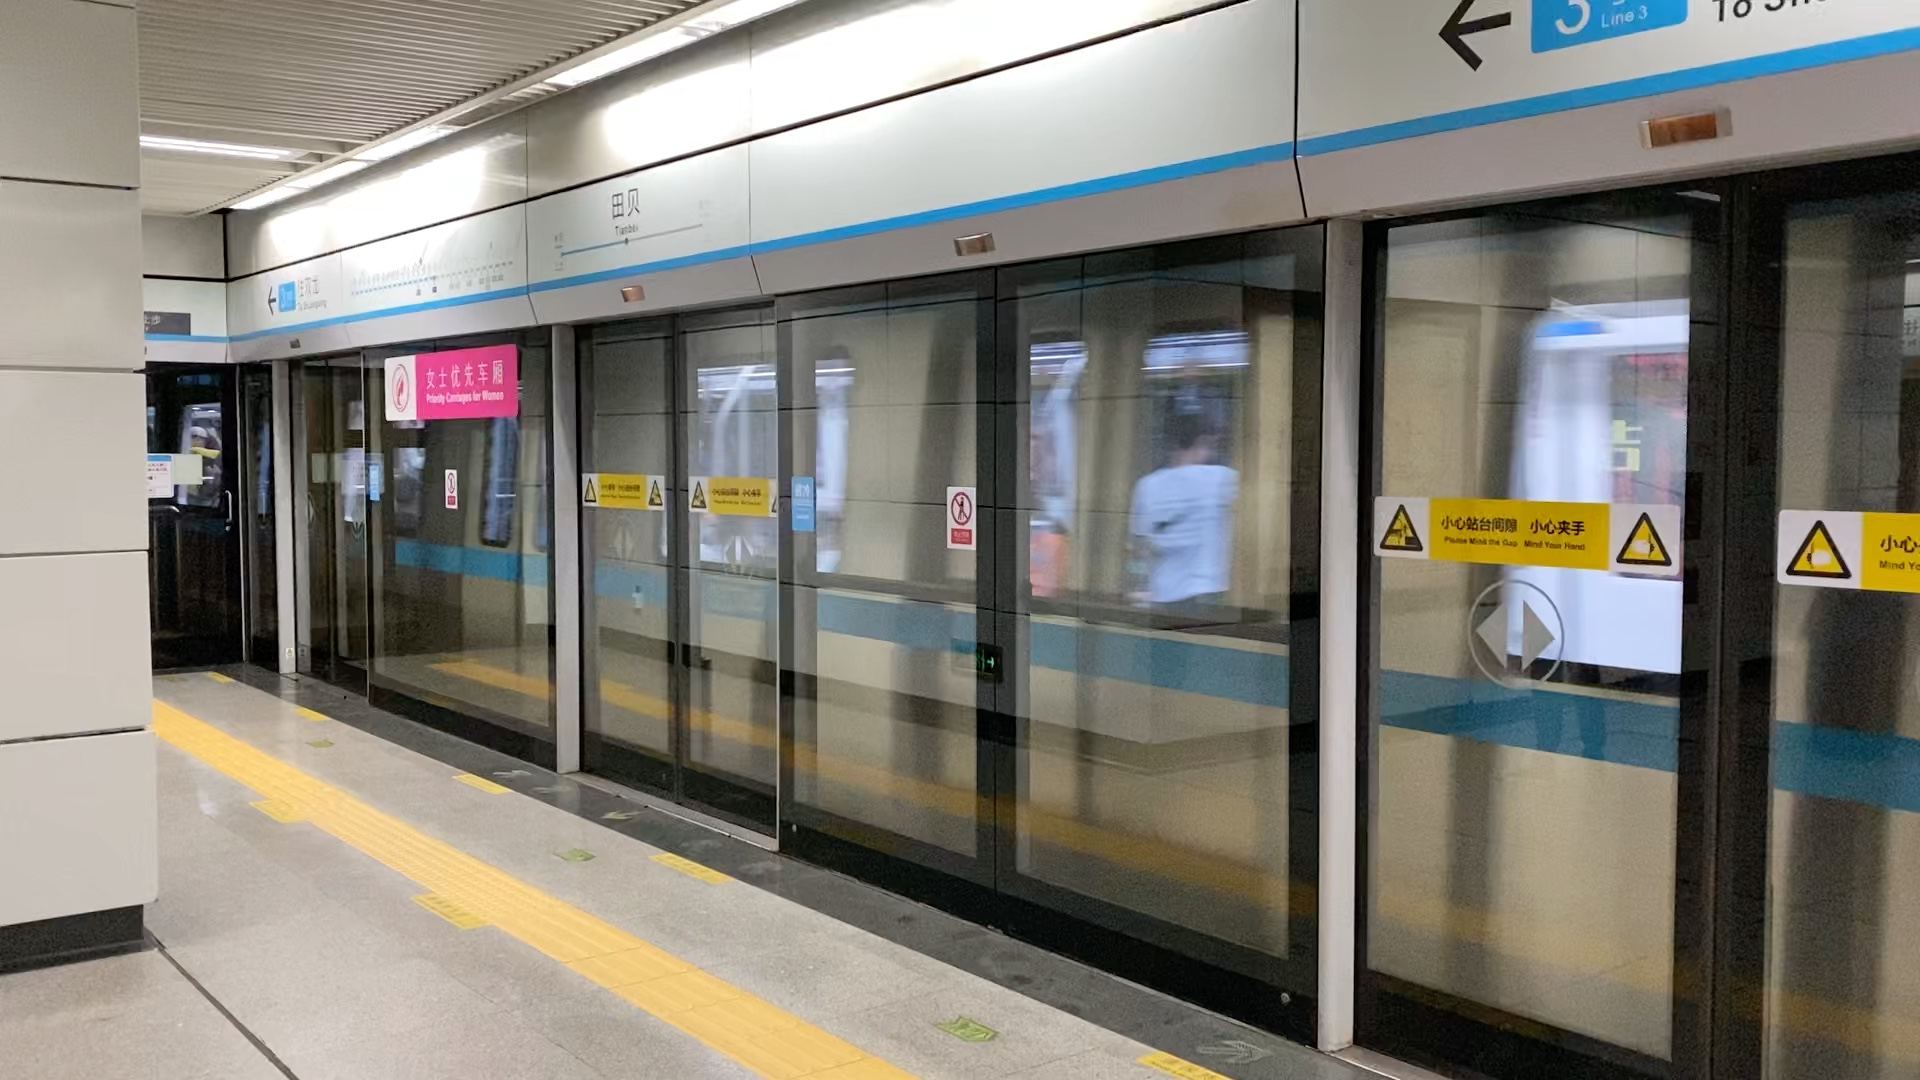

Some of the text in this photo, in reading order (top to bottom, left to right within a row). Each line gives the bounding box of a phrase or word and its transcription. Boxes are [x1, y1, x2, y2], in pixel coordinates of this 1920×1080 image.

[1601, 5, 1648, 28] Line 3
[1712, 0, 1752, 22] To
[612, 188, 640, 219] 田贝
[615, 224, 638, 236] Tianbei
[426, 360, 503, 390] 女士优先车厢
[426, 393, 445, 405] Priority
[446, 392, 471, 404] Carriages
[482, 390, 504, 401] Women
[1441, 516, 1585, 535] 小心站台间隙 小心夹手
[1502, 540, 1518, 548] Gap
[1524, 540, 1543, 548] Mind
[1564, 542, 1585, 551] Hand
[1880, 535, 1920, 553] 小心
[1880, 560, 1905, 569] Mind
